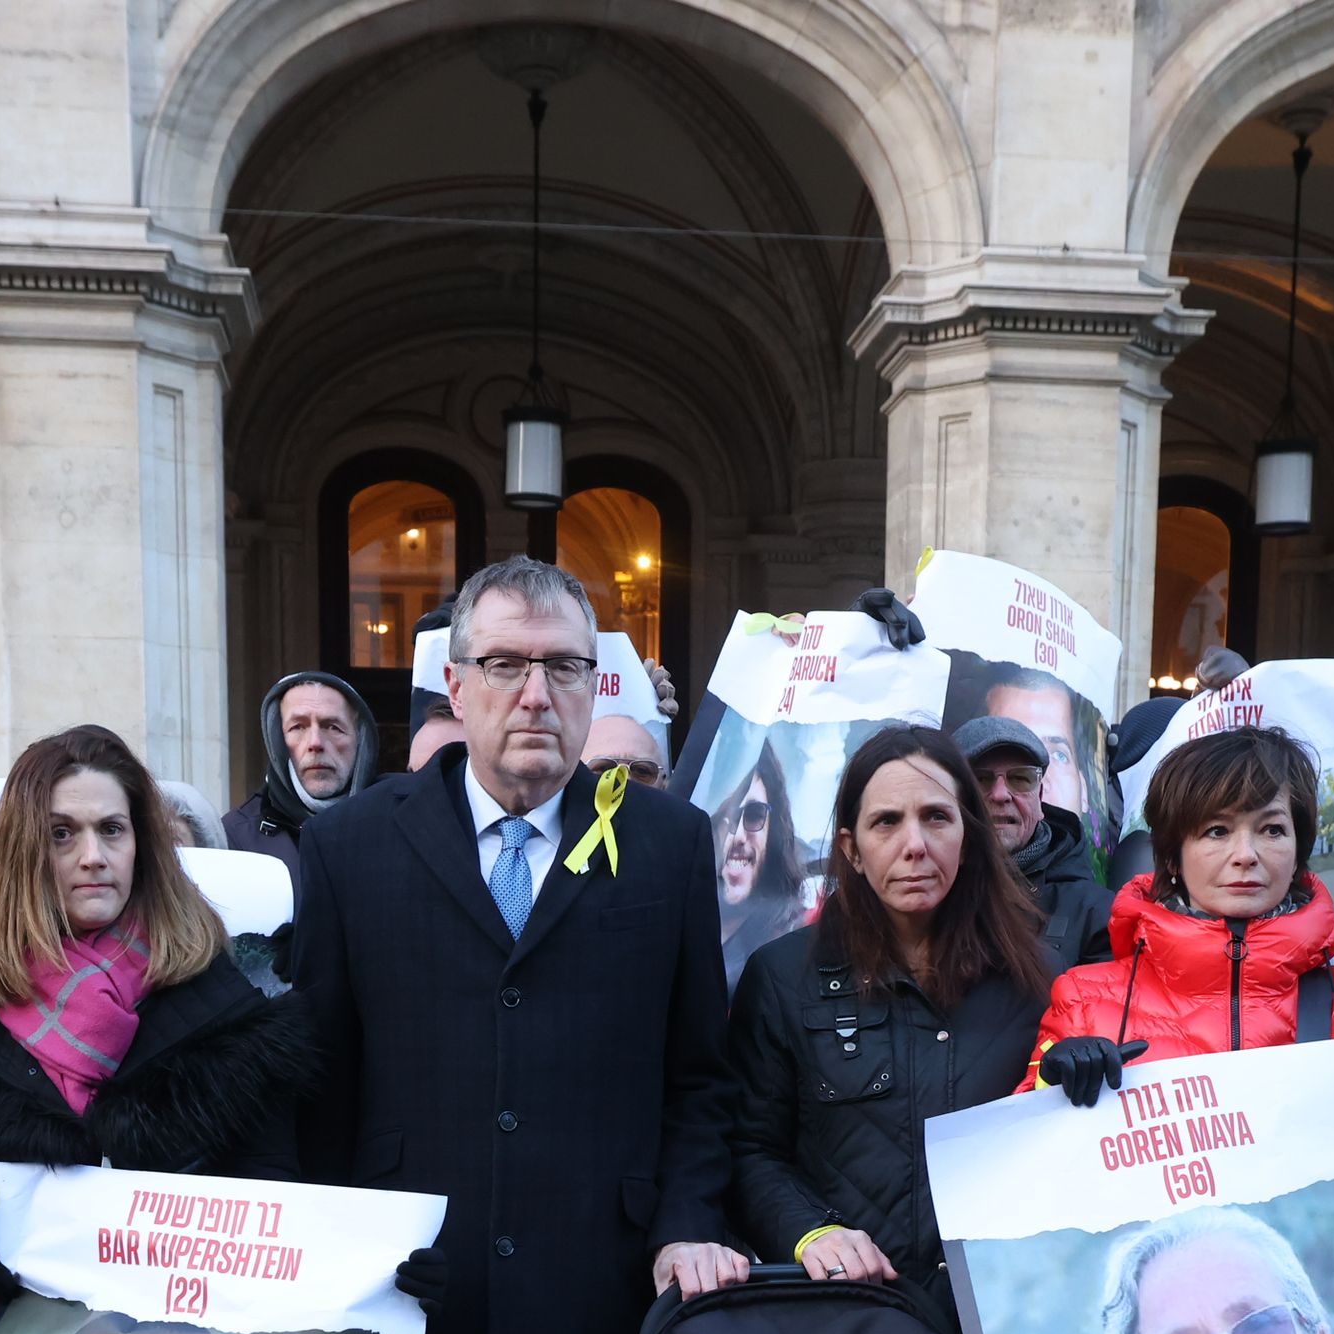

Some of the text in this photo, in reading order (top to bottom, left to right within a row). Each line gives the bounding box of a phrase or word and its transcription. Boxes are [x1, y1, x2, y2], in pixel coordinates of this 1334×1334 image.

[1014, 578, 1047, 612] שאול
[1007, 604, 1077, 657] ORON SHAUL
[1034, 638, 1058, 672] (30)
[1188, 707, 1225, 740] EITAN
[1117, 1074, 1219, 1129] מיה גורן
[1100, 1111, 1255, 1171] GOREN MAYA
[1163, 1156, 1216, 1205] (56)
[127, 1190, 283, 1239] בר קופרשטיין
[98, 1227, 303, 1281] BAR KUPERSHTEIN
[165, 1273, 208, 1318] (22)
